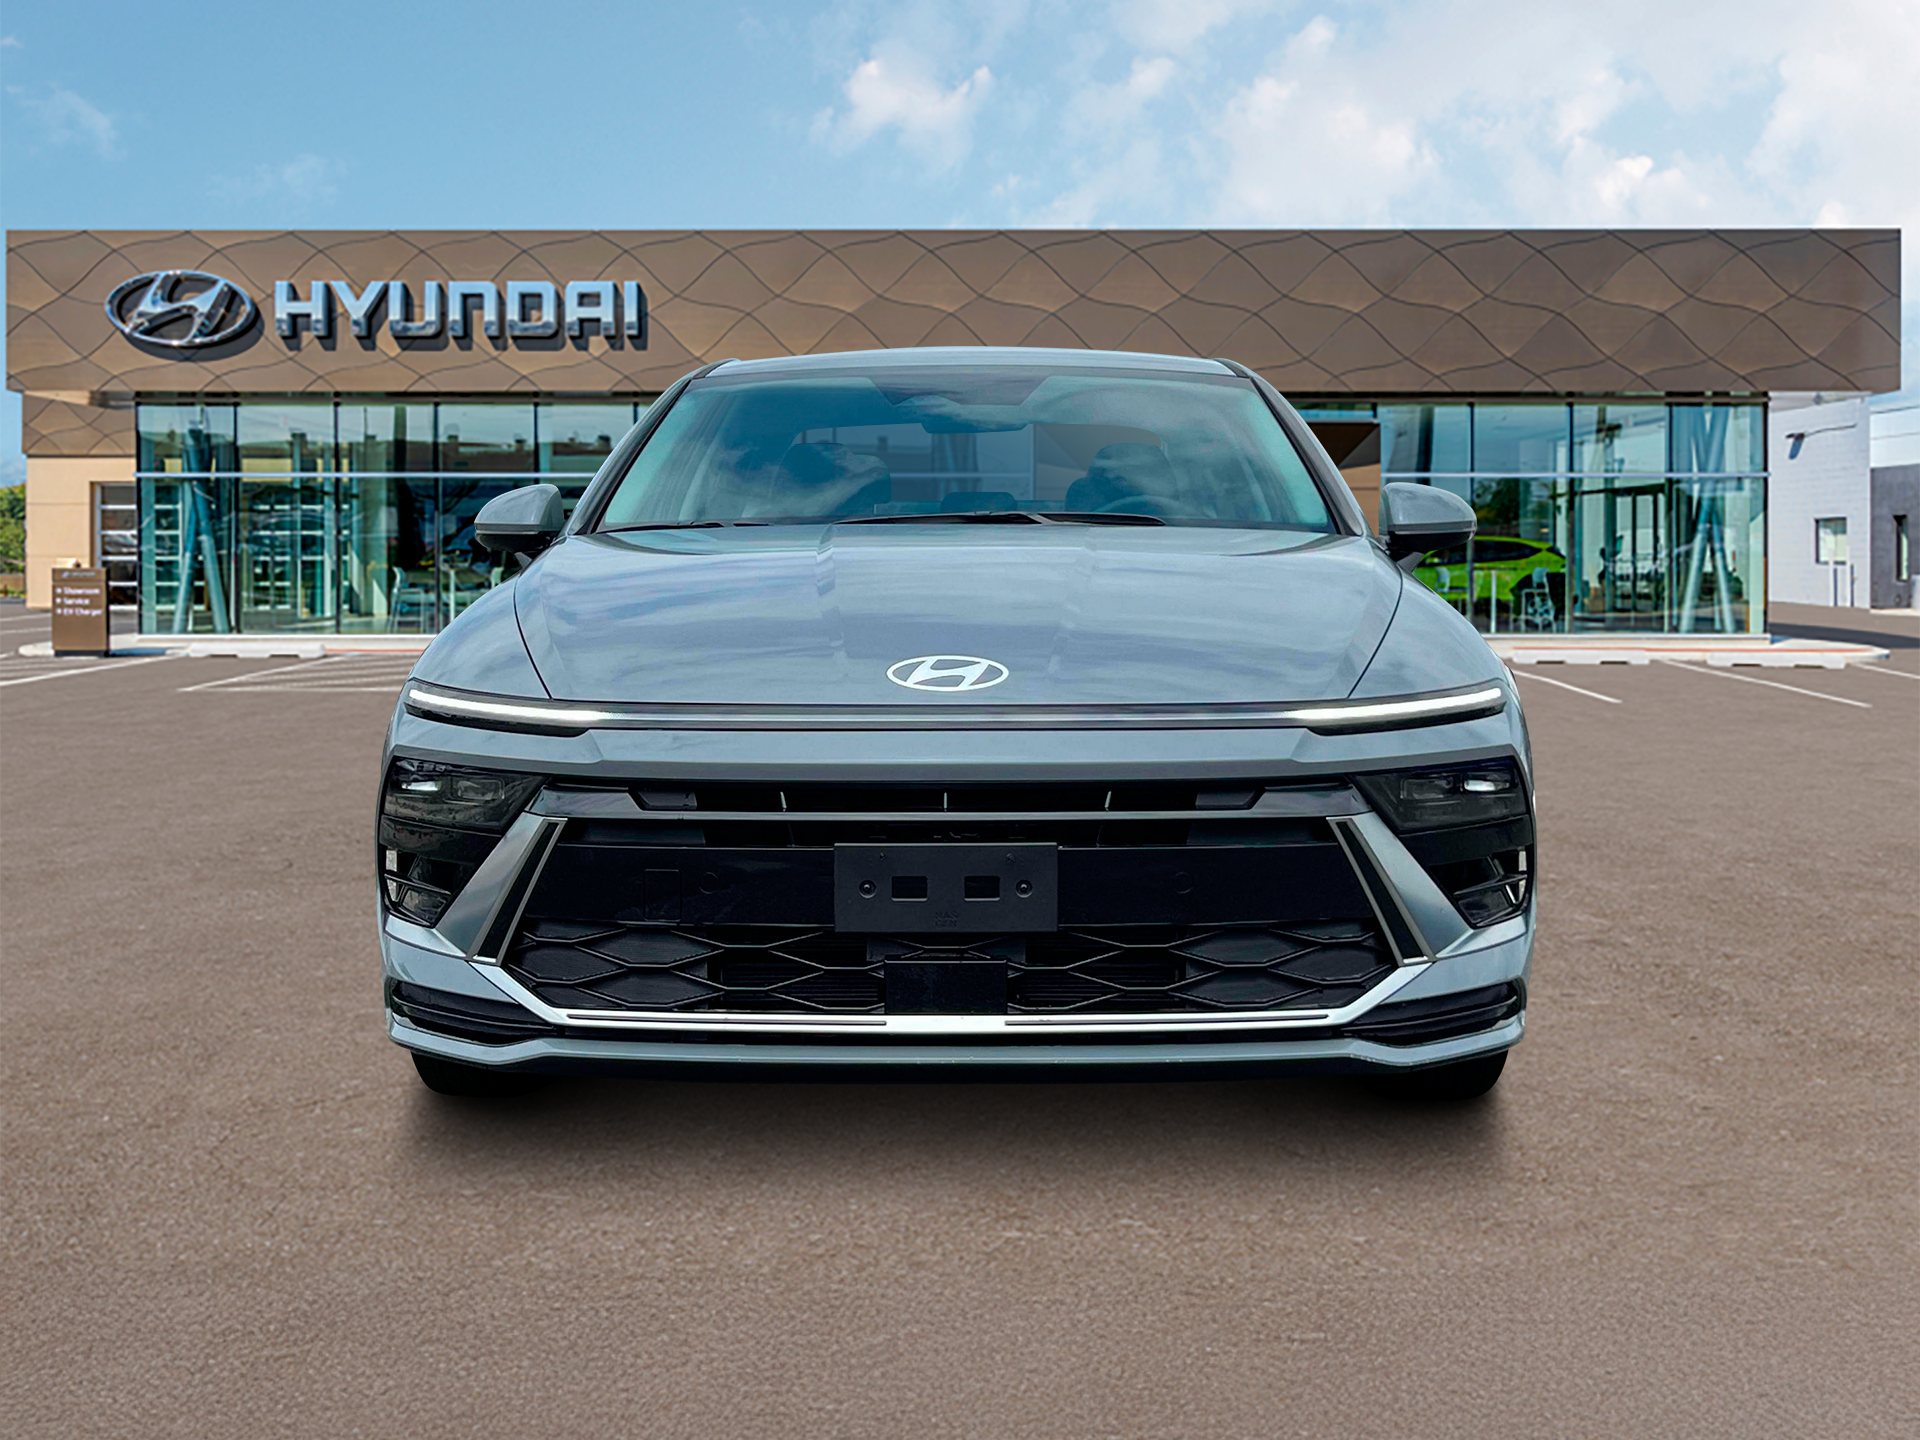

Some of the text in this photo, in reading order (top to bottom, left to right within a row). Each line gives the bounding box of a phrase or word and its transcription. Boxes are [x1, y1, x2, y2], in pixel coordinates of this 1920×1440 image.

[275, 280, 643, 344] HYUNDAI
[63, 587, 100, 595] Showroom
[63, 597, 90, 605] Service
